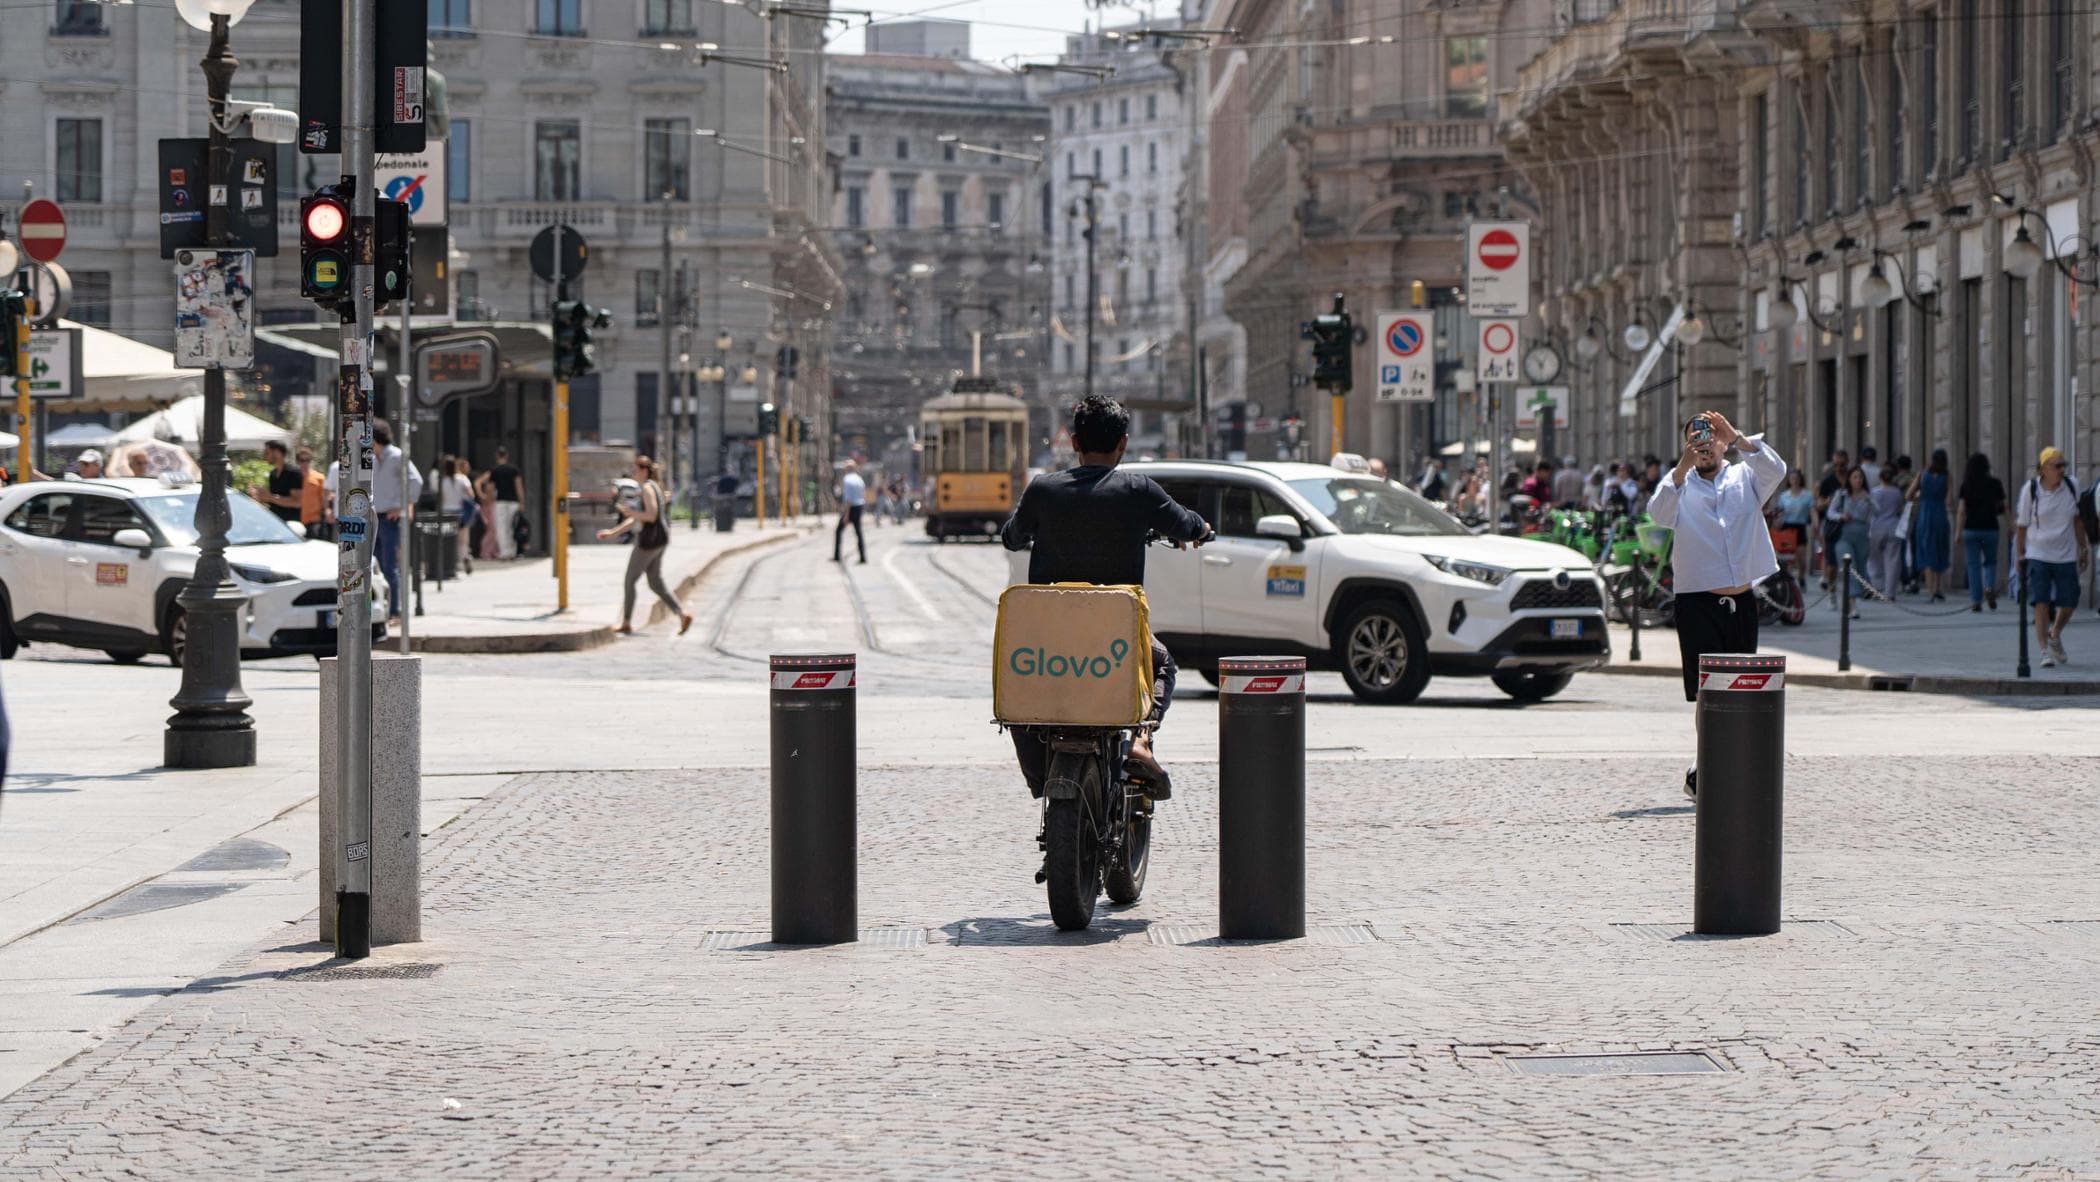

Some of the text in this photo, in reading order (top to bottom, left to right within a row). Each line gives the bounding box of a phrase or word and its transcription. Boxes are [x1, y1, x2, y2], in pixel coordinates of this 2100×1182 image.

[395, 68, 405, 121] SIBESTAR
[376, 158, 429, 170] pedonale
[1010, 647, 1112, 679] Glovo
